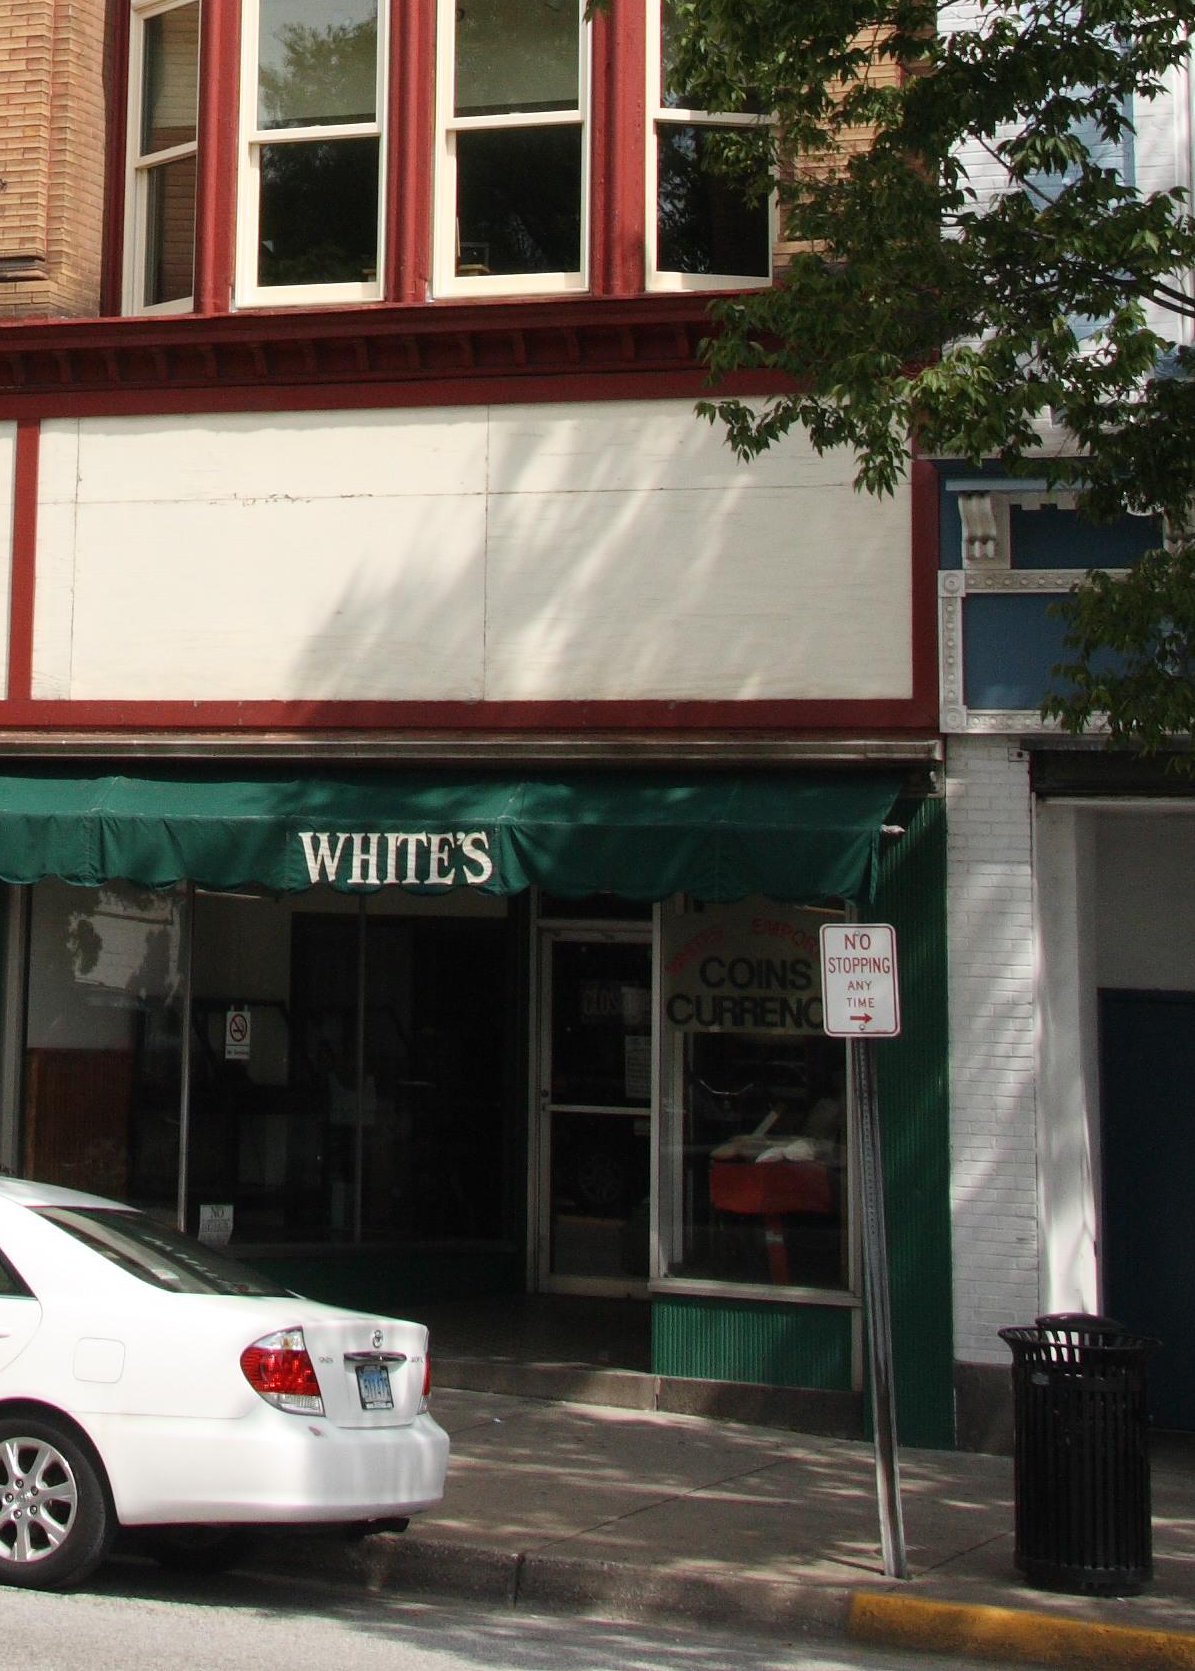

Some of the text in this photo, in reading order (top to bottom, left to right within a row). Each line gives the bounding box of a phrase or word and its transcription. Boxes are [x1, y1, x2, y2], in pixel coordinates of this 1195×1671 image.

[298, 831, 493, 885] WHITE'S
[844, 933, 871, 950] NO
[699, 956, 812, 990] COINS
[828, 956, 891, 974] STOPPING
[847, 980, 872, 991] ANY
[666, 992, 824, 1029] CURRENC
[846, 997, 875, 1008] TIME
